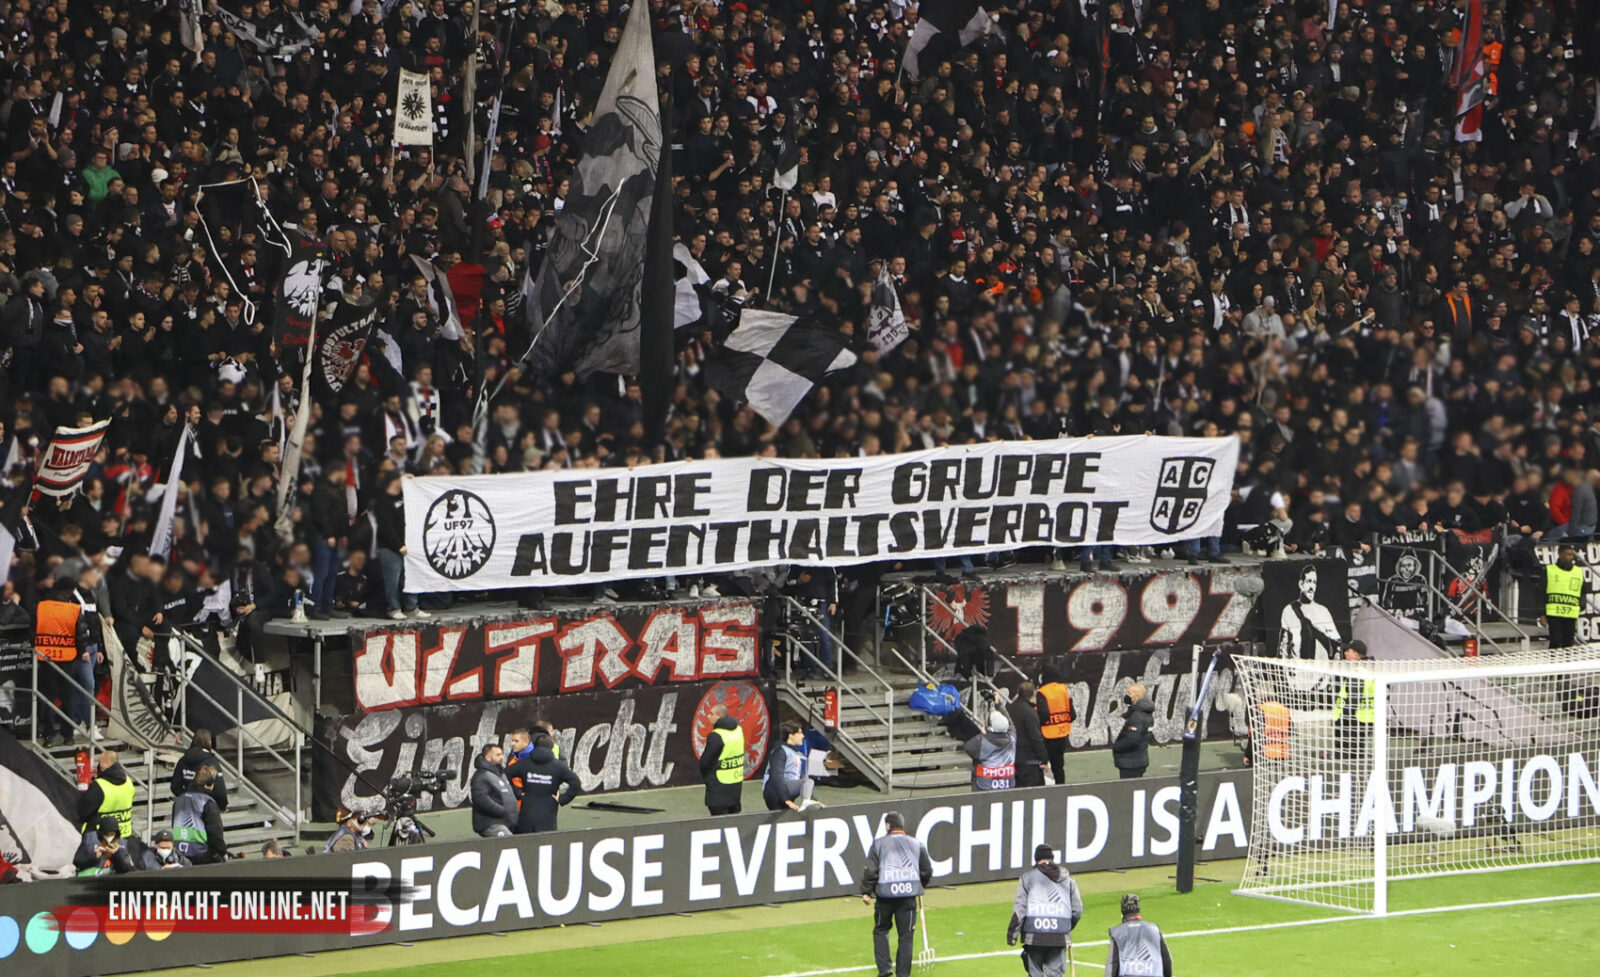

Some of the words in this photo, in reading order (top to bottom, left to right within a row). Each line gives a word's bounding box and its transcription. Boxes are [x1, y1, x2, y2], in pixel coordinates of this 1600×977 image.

[553, 472, 712, 526] EHRE
[746, 467, 862, 512] DER
[892, 452, 1101, 503] GRUPPE
[444, 519, 474, 531] UF97
[510, 501, 1129, 577] AUFENTHALTSVERBOT
[1006, 571, 1262, 655] 1997
[34, 636, 75, 647] TEWAR
[45, 649, 63, 658] 211
[355, 605, 760, 713] ULTRAS
[340, 692, 677, 814] Eintcht
[991, 779, 1010, 789] 031
[350, 834, 665, 937] BECAUSE
[914, 794, 1110, 877] CHILD
[1132, 785, 1181, 857] IS
[1201, 781, 1249, 851] A
[884, 866, 918, 880] PITCH
[890, 882, 912, 895] 008
[1027, 903, 1065, 915] PITCH
[1033, 918, 1059, 930] 003
